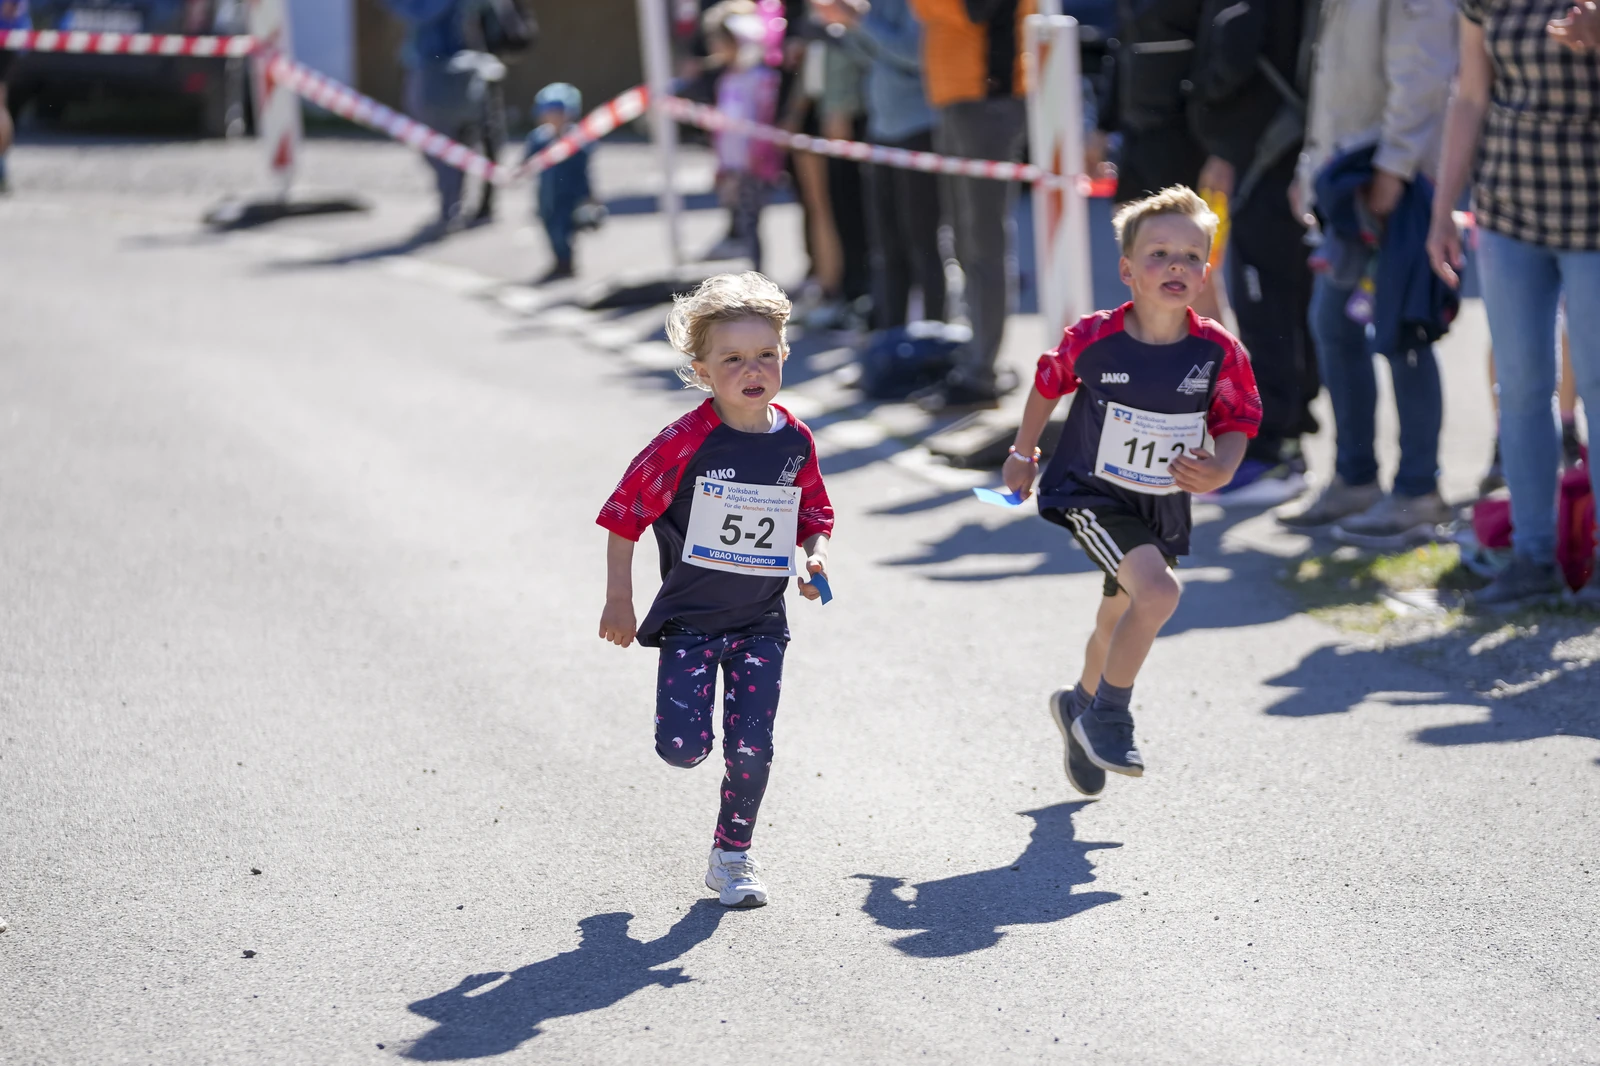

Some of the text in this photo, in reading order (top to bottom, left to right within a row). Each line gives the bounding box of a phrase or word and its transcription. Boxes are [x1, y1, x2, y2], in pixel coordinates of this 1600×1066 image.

[1101, 373, 1129, 383] JAKO
[706, 468, 735, 480] JAKO
[727, 486, 759, 496] Volksbank
[720, 514, 775, 549] 5-2
[709, 549, 776, 565] VBAO Voralpencup
